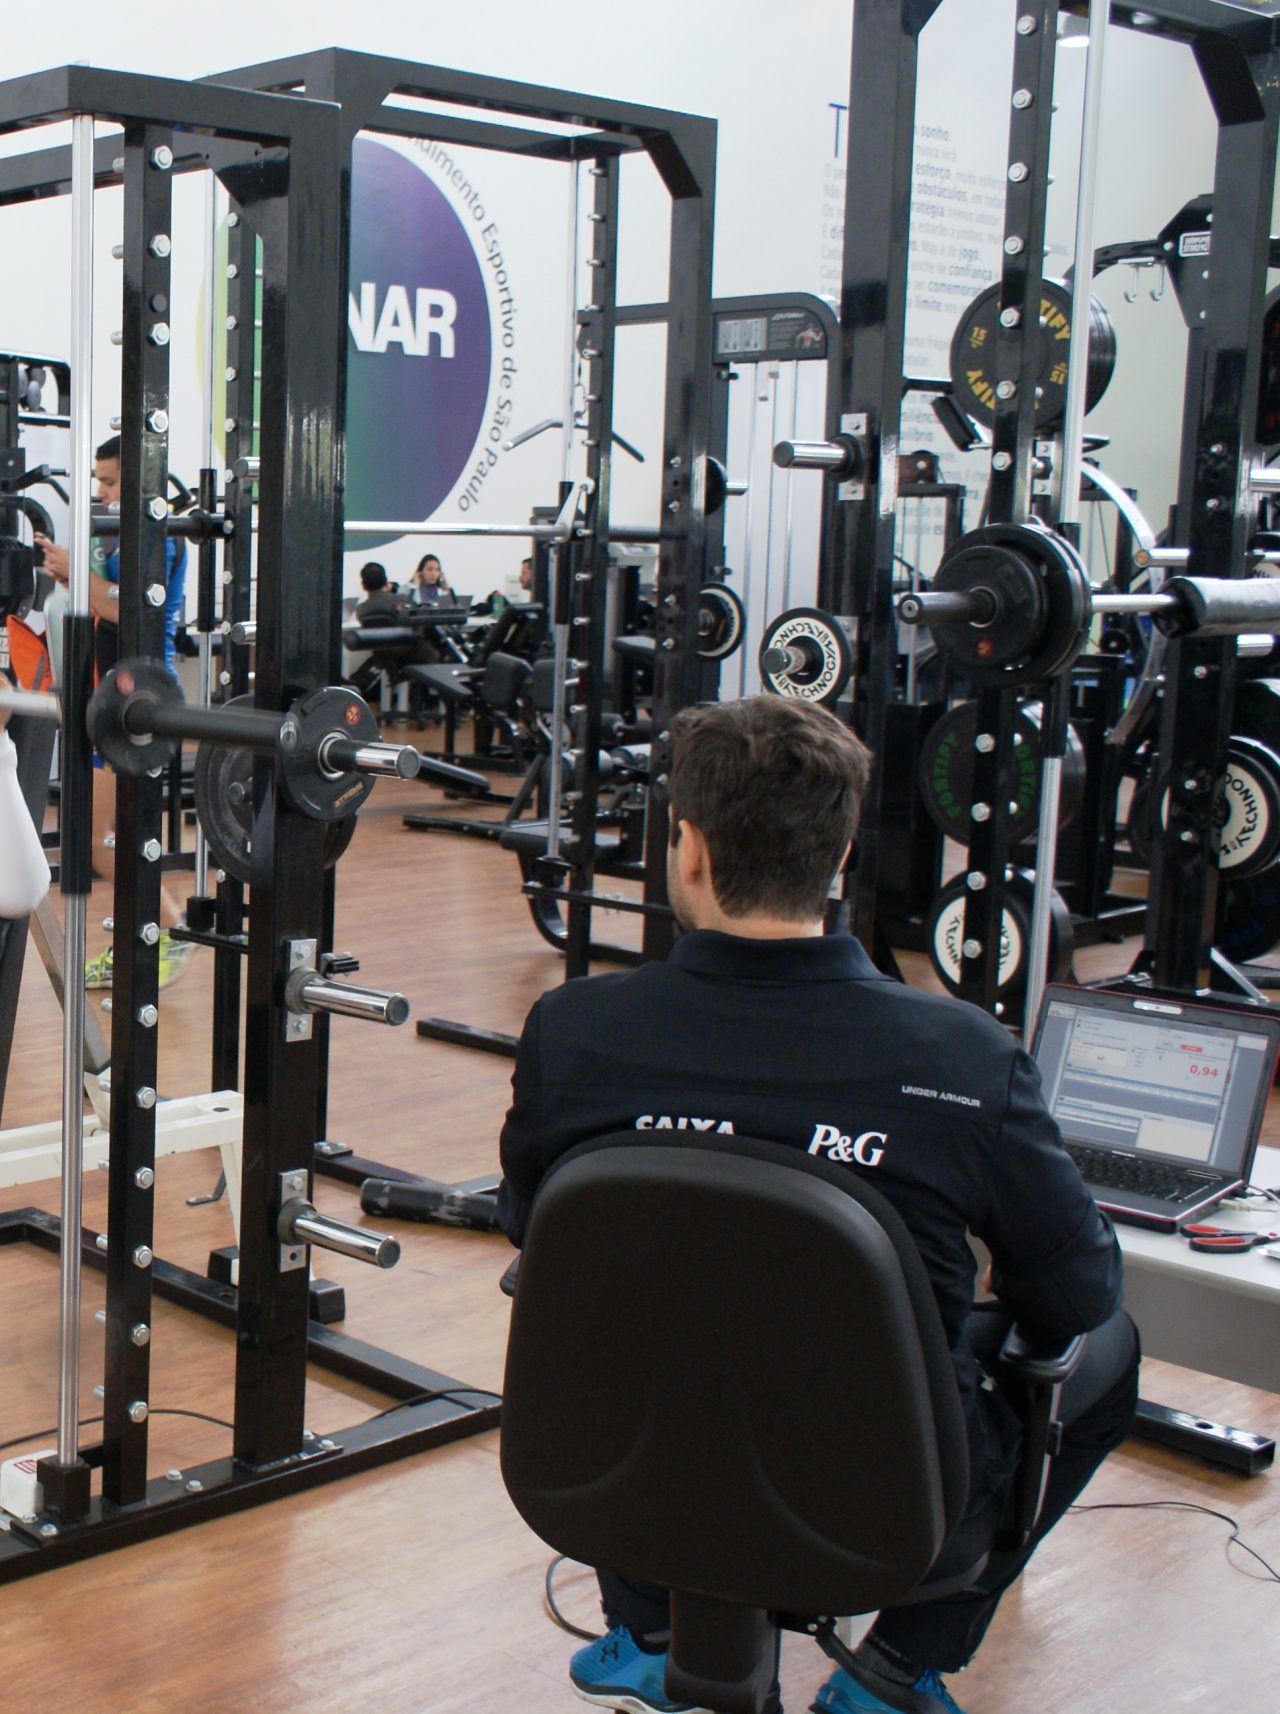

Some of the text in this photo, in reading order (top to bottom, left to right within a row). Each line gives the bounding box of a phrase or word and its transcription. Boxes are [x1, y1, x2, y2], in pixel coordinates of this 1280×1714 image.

[481, 222, 518, 350] Esportivo
[928, 280, 982, 298] comemora
[348, 281, 458, 359] NAR
[972, 326, 988, 341] 15
[499, 356, 518, 389] de
[489, 396, 513, 443] São
[458, 448, 499, 512] Paulo
[933, 731, 962, 819] FORTIFY
[1015, 744, 1036, 814] ORTIF
[1223, 772, 1259, 848] TECHNO
[945, 914, 962, 966] TECHN
[1189, 1064, 1218, 1078] 0,94
[901, 1084, 981, 1108] UNDER ARMOUR
[807, 1123, 889, 1167] P&G
